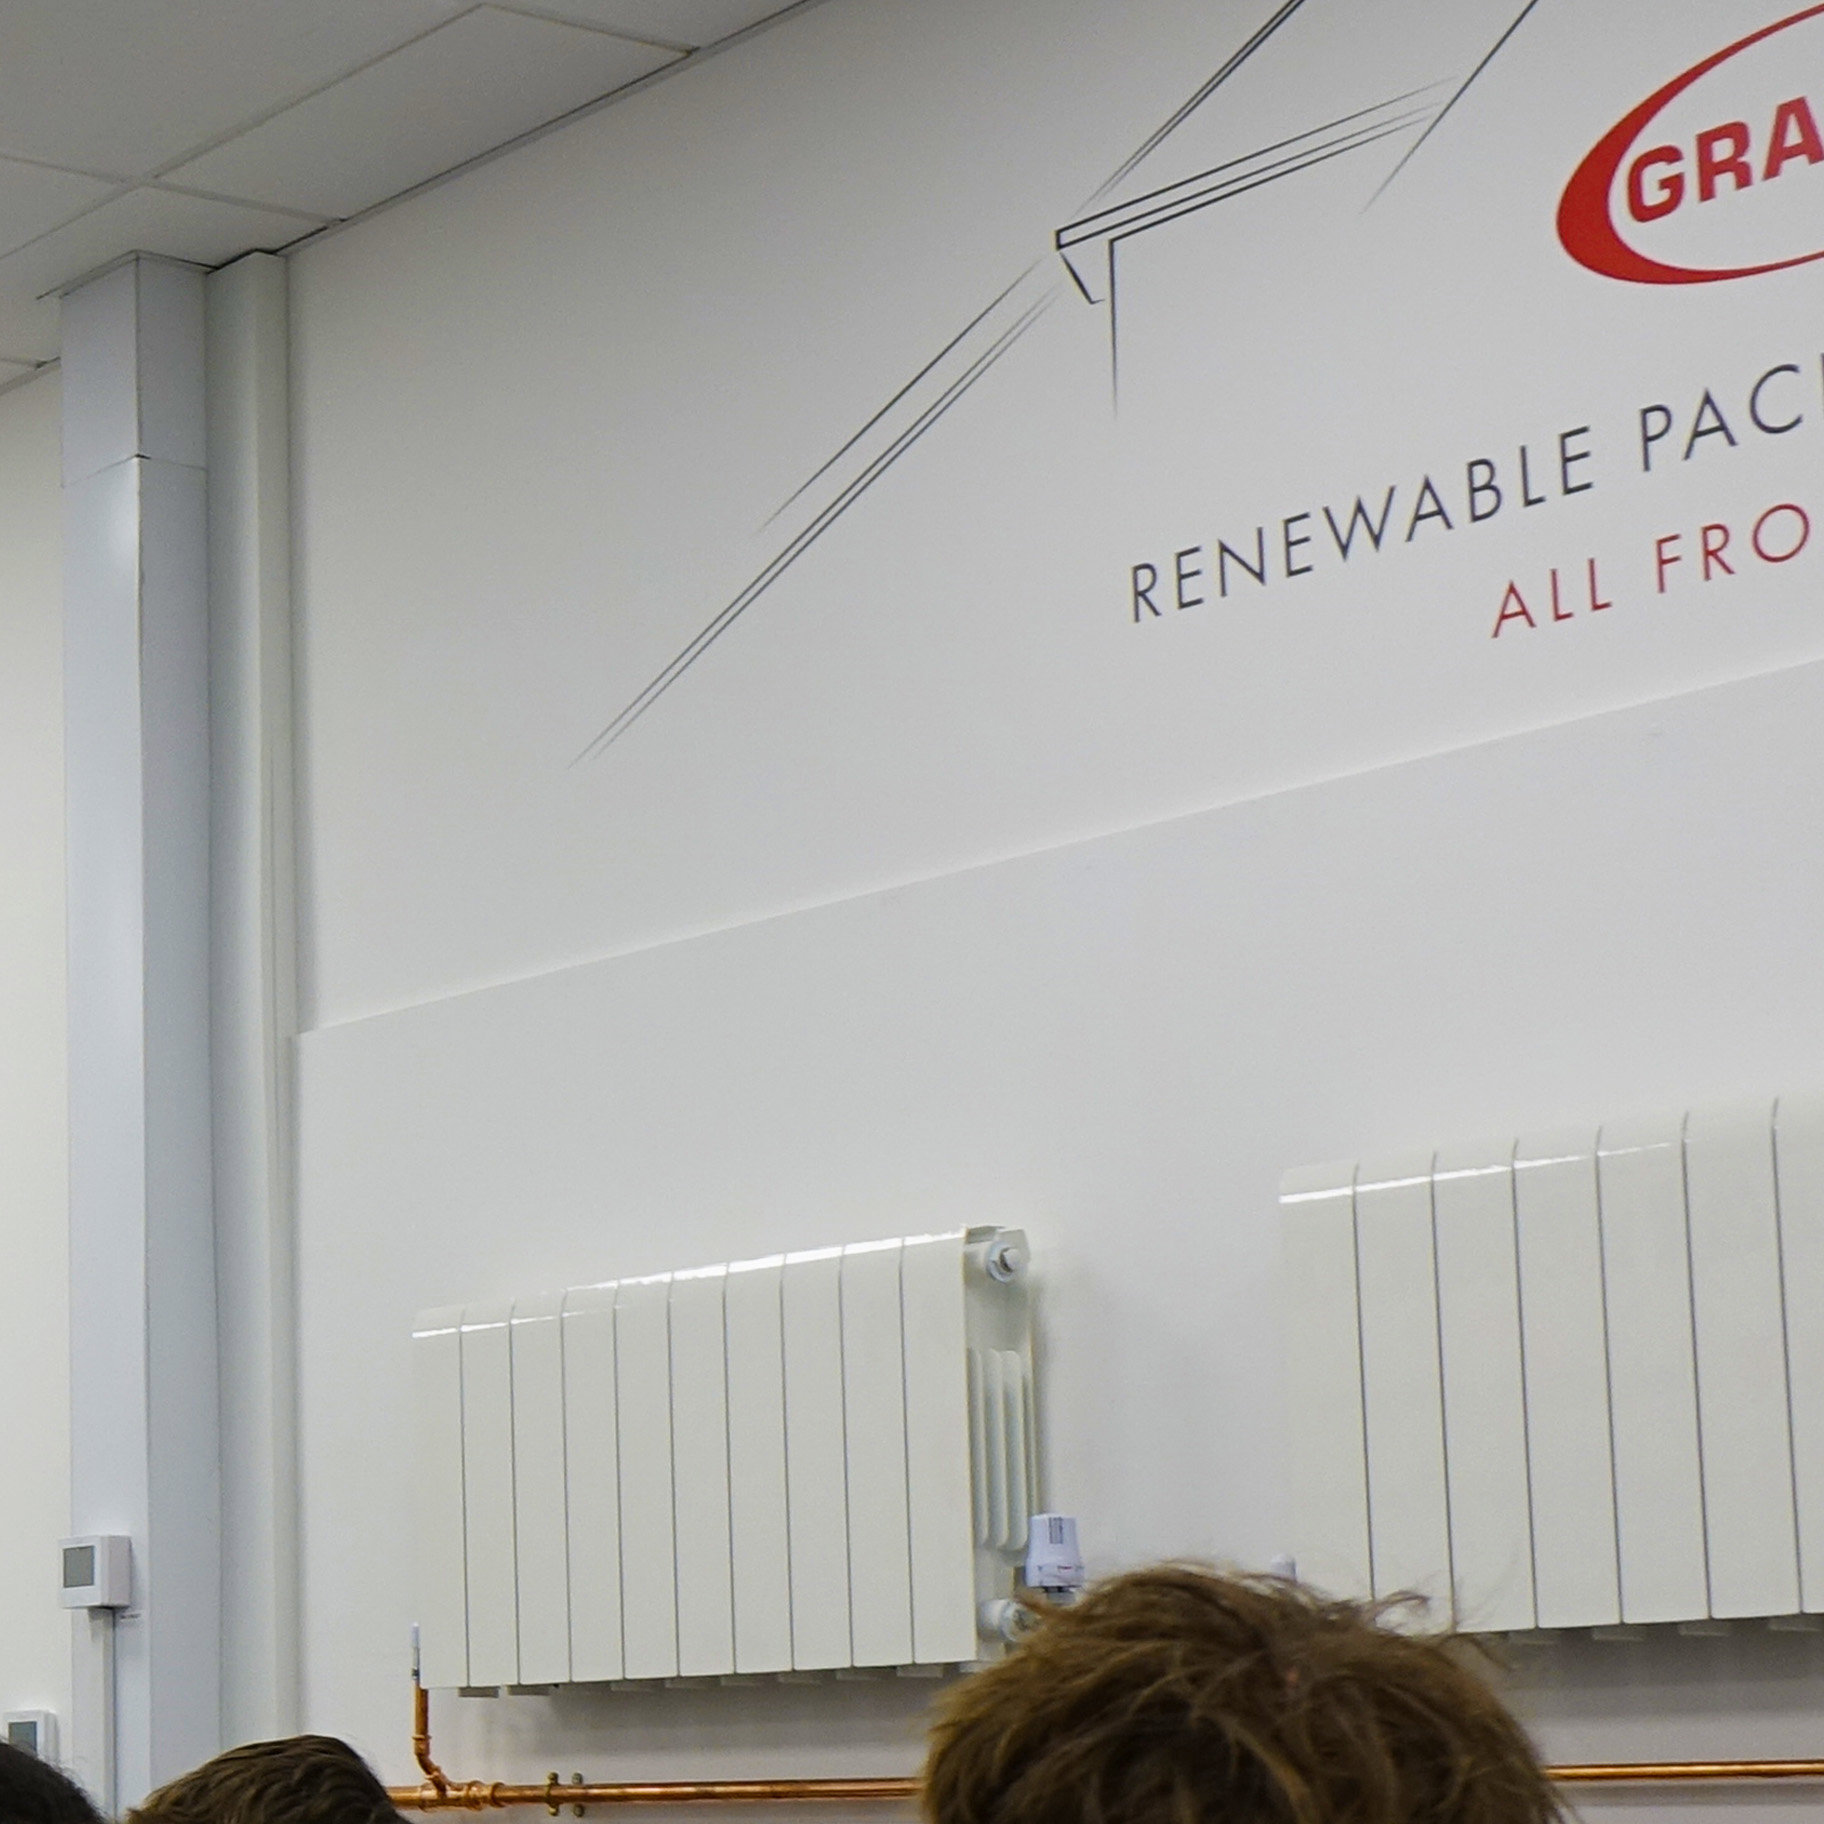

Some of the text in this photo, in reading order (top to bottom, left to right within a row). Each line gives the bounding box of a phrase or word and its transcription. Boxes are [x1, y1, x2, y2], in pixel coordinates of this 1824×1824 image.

[1627, 95, 1824, 224] GRA
[1132, 352, 1824, 624] RENEWABLE PAC
[1491, 502, 1811, 638] ALL FRO
